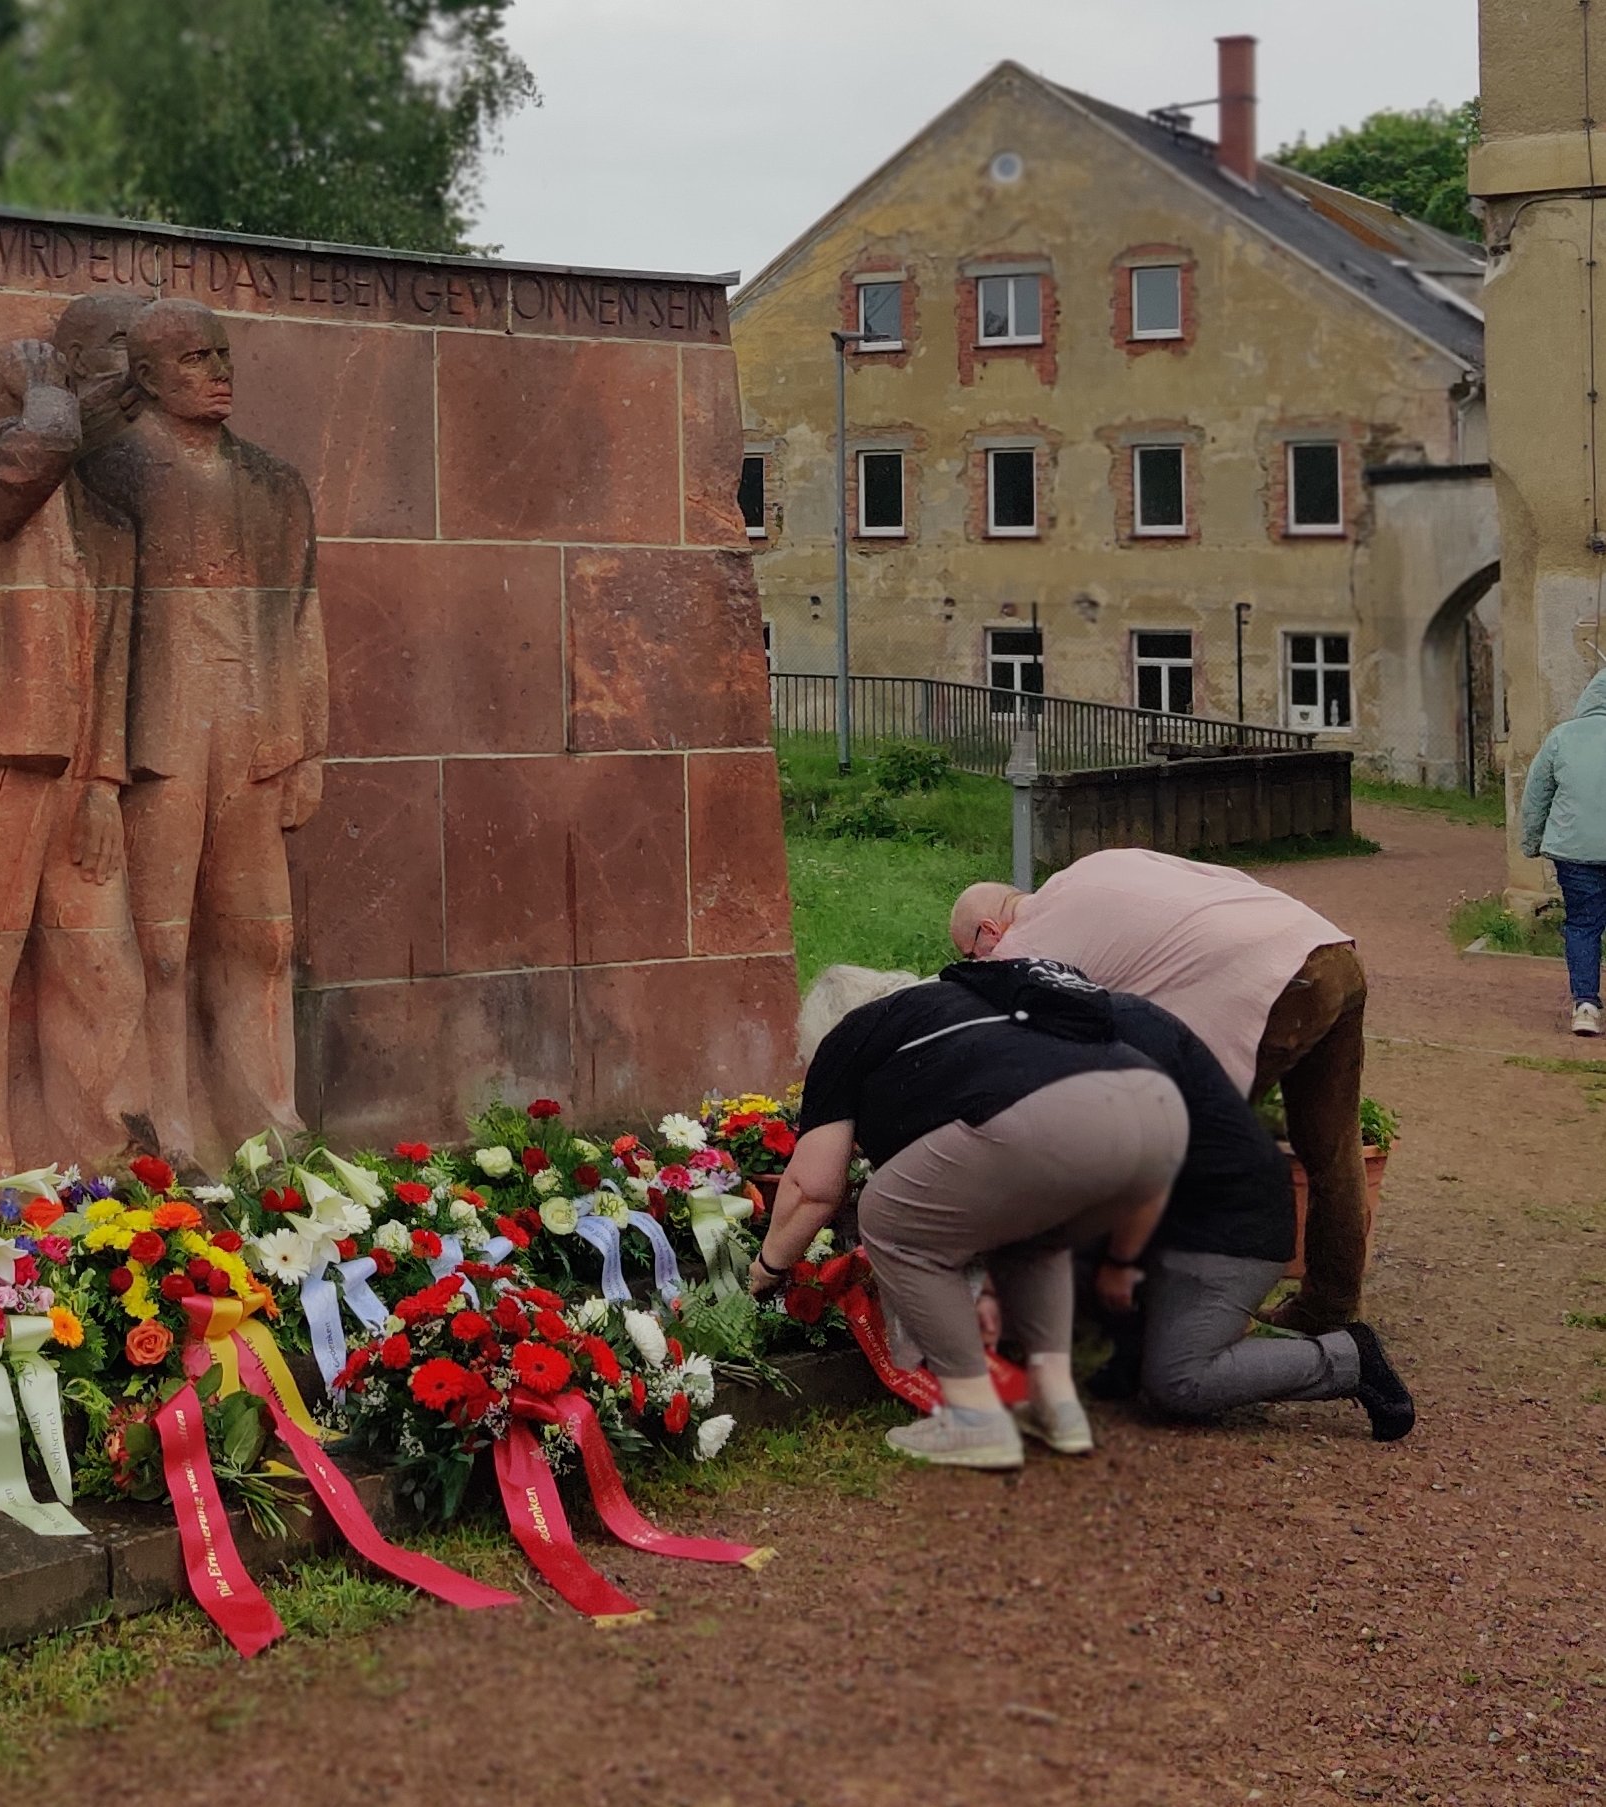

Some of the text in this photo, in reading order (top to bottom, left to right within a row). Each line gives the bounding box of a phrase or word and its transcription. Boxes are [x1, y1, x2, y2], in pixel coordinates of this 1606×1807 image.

[89, 234, 195, 290] EUCH
[208, 248, 278, 300] DAS
[291, 256, 395, 309] LEBEN
[410, 273, 638, 327] GEWONNEN
[215, 1578, 235, 1598] Die
